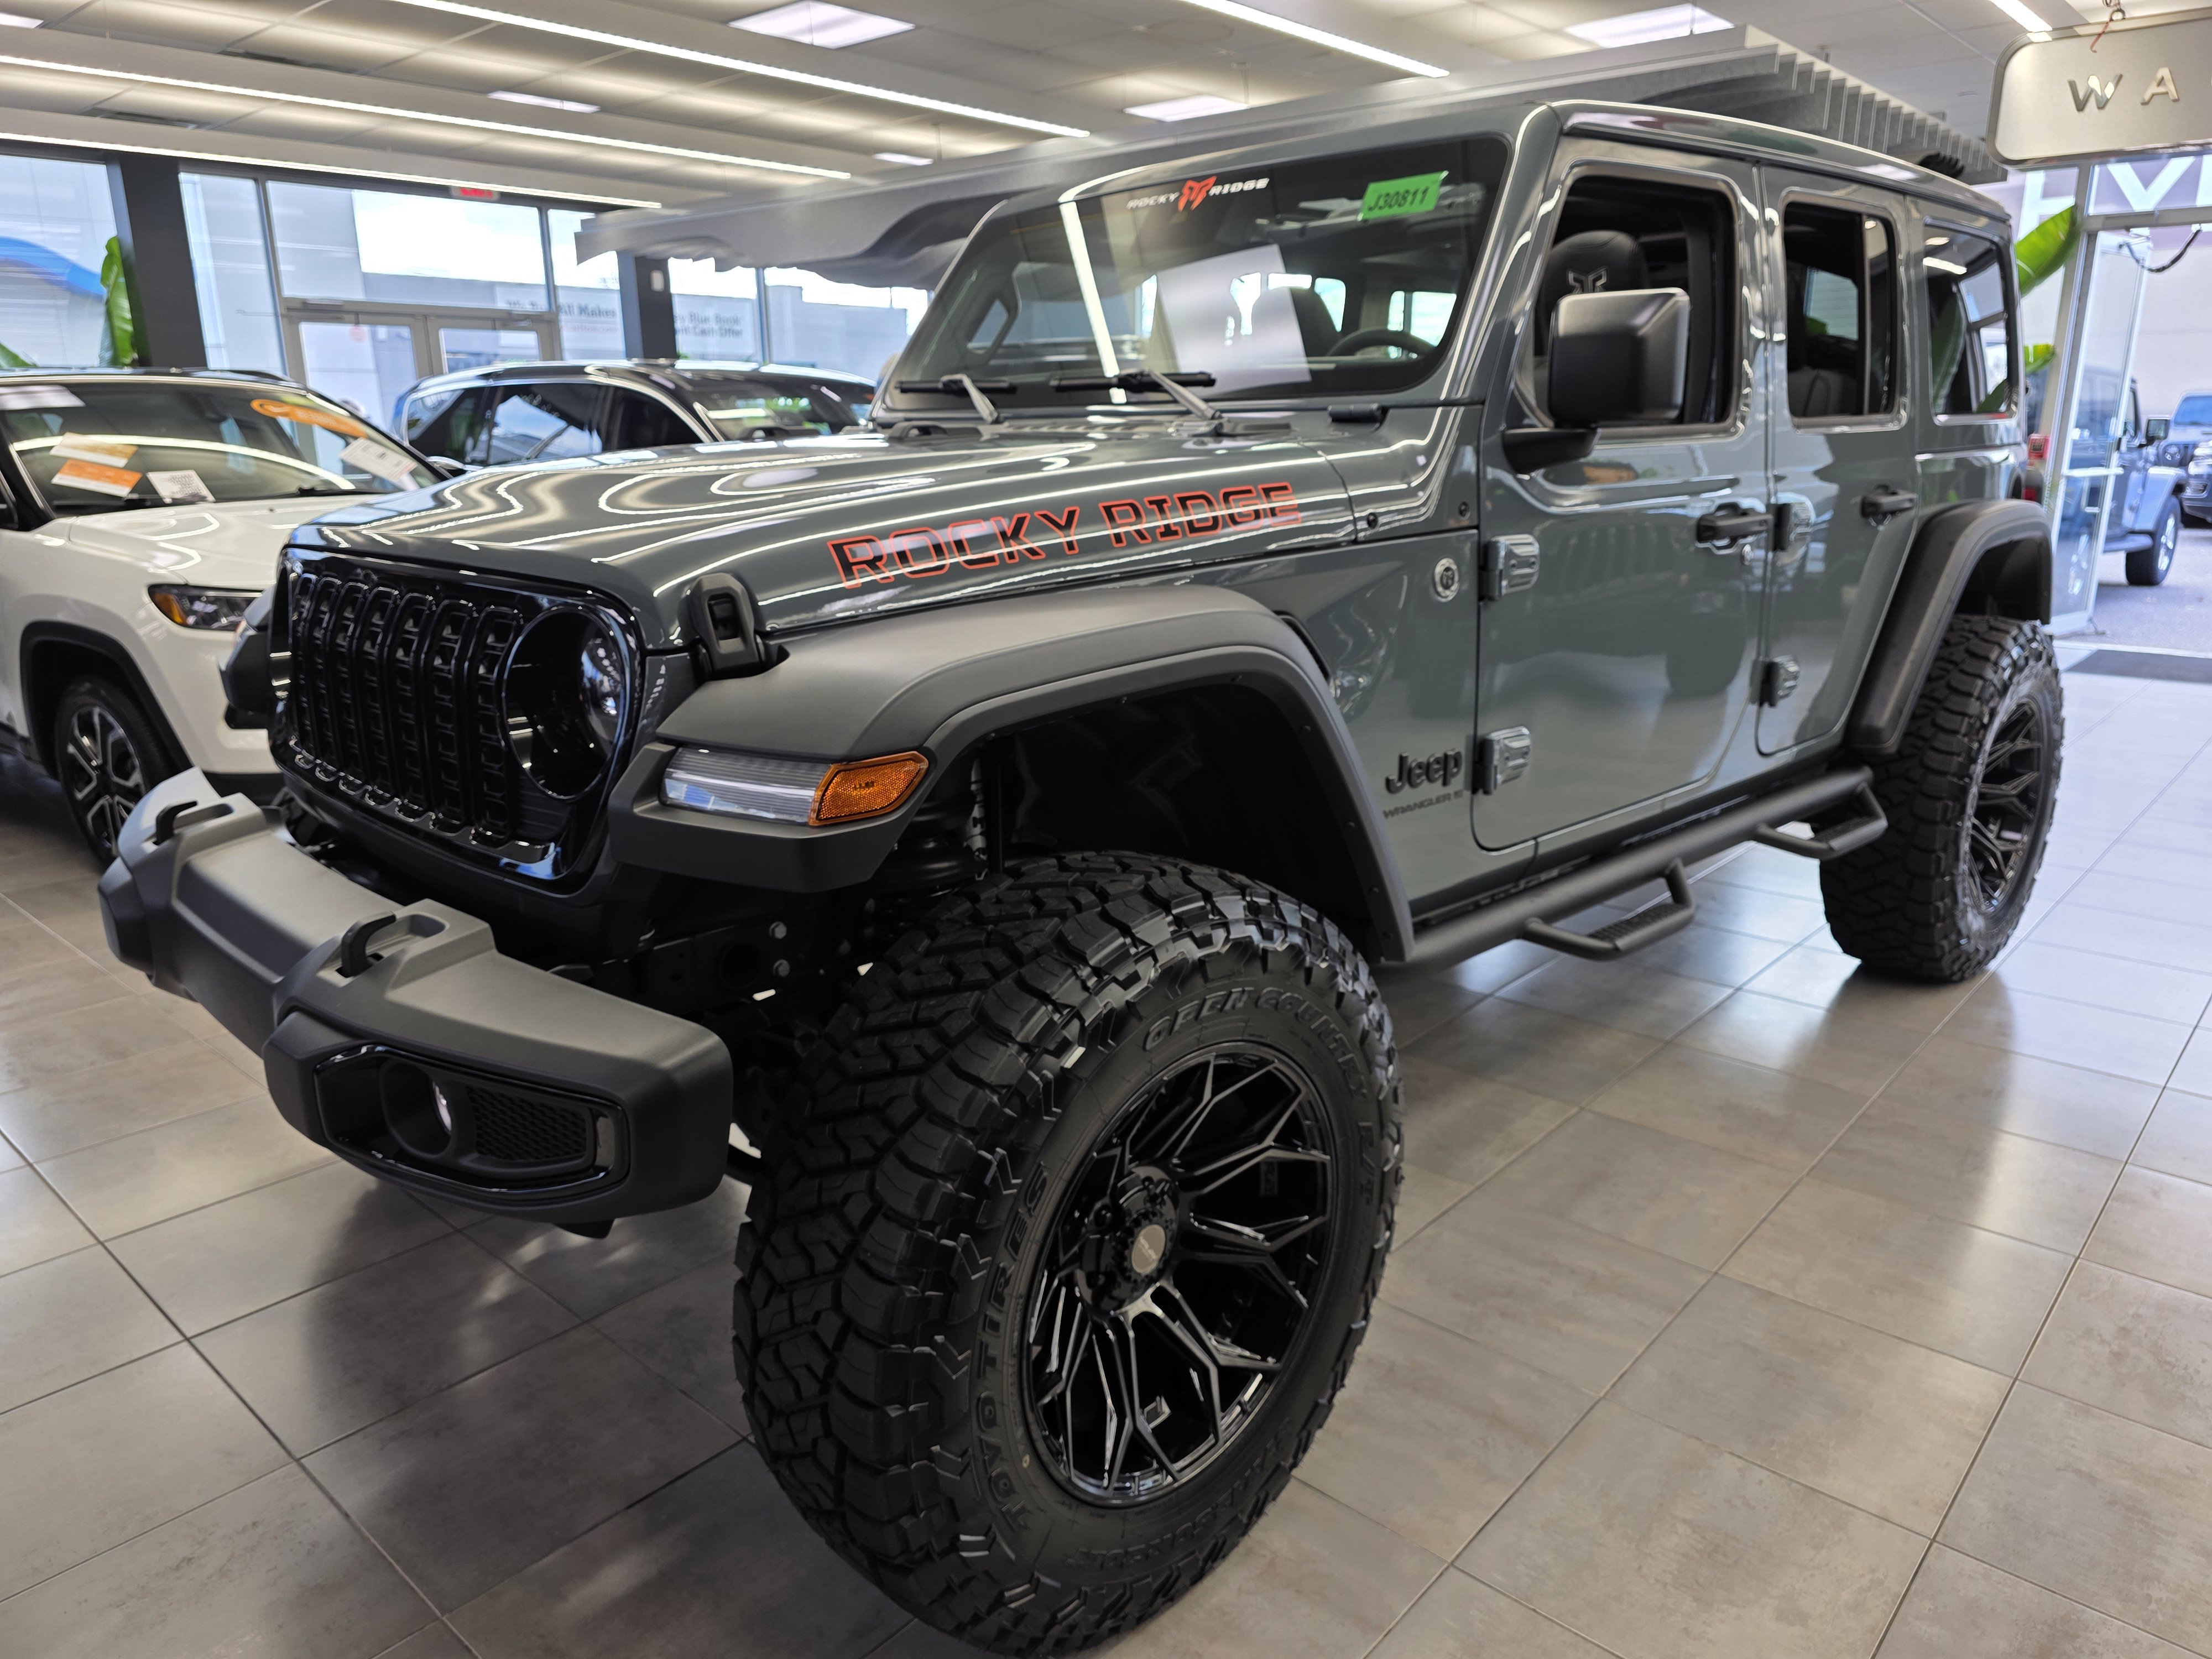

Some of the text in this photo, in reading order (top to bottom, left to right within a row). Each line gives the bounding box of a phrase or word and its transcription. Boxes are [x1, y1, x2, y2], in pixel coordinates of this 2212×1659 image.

[1126, 178, 1270, 210] ROCKY RIDGE
[1368, 186, 1430, 211] J30811
[827, 482, 1302, 590] ROCKY RIDGE
[1385, 748, 1463, 795] Jeep
[1145, 987, 1254, 1051] OPEN
[1256, 987, 1368, 1098] COUNTRY
[977, 1160, 1050, 1380] TIRES
